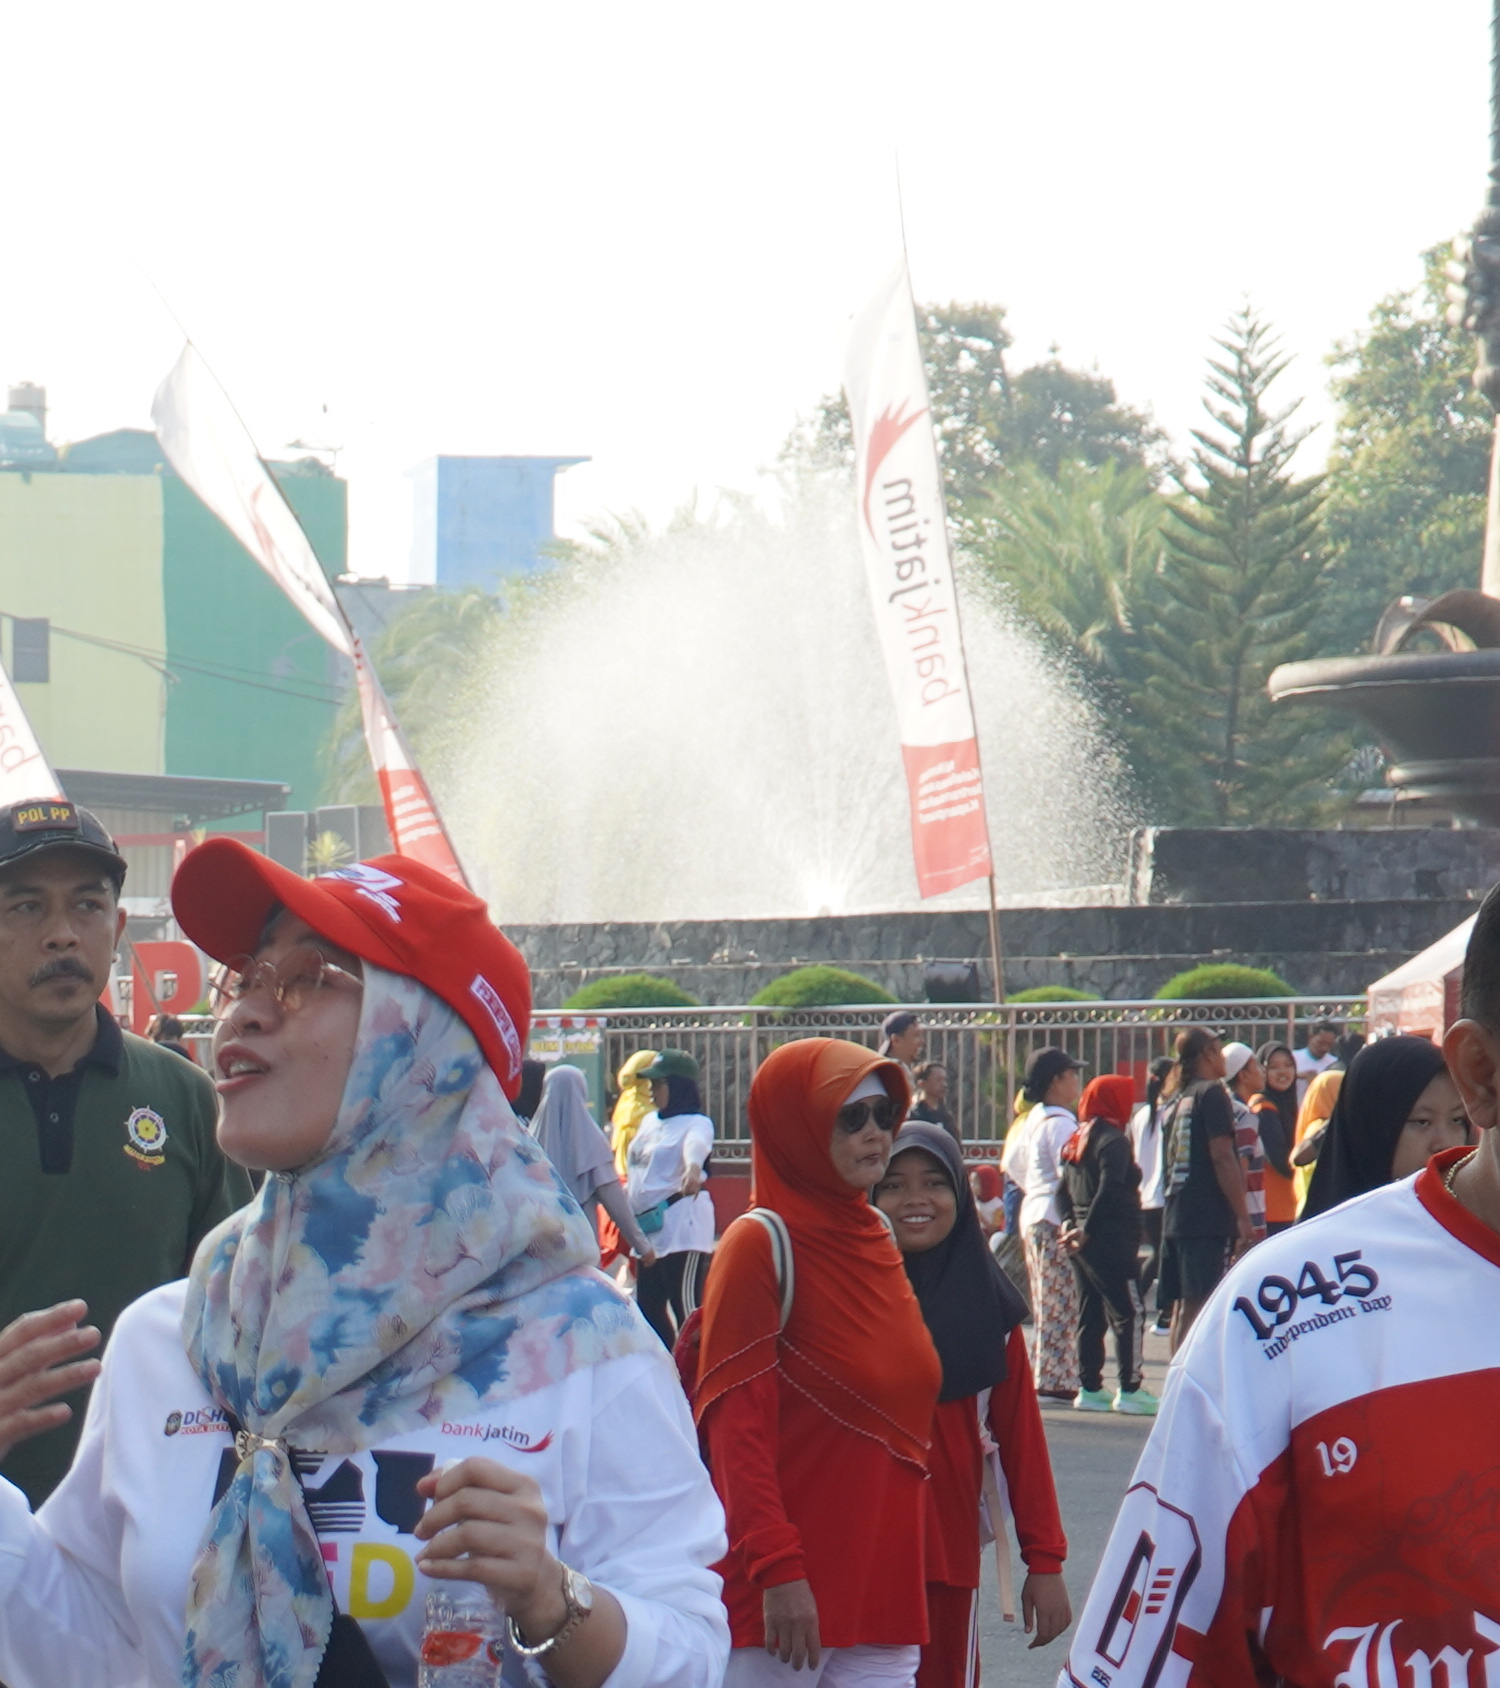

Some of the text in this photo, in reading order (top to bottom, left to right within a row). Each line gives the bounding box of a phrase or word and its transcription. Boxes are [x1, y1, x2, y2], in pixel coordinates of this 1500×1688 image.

[17, 806, 71, 825] POL PP
[1233, 1249, 1379, 1340] 1945
[1357, 1294, 1393, 1313] day
[441, 1420, 530, 1446] bankjatim
[1315, 1436, 1358, 1477] 19
